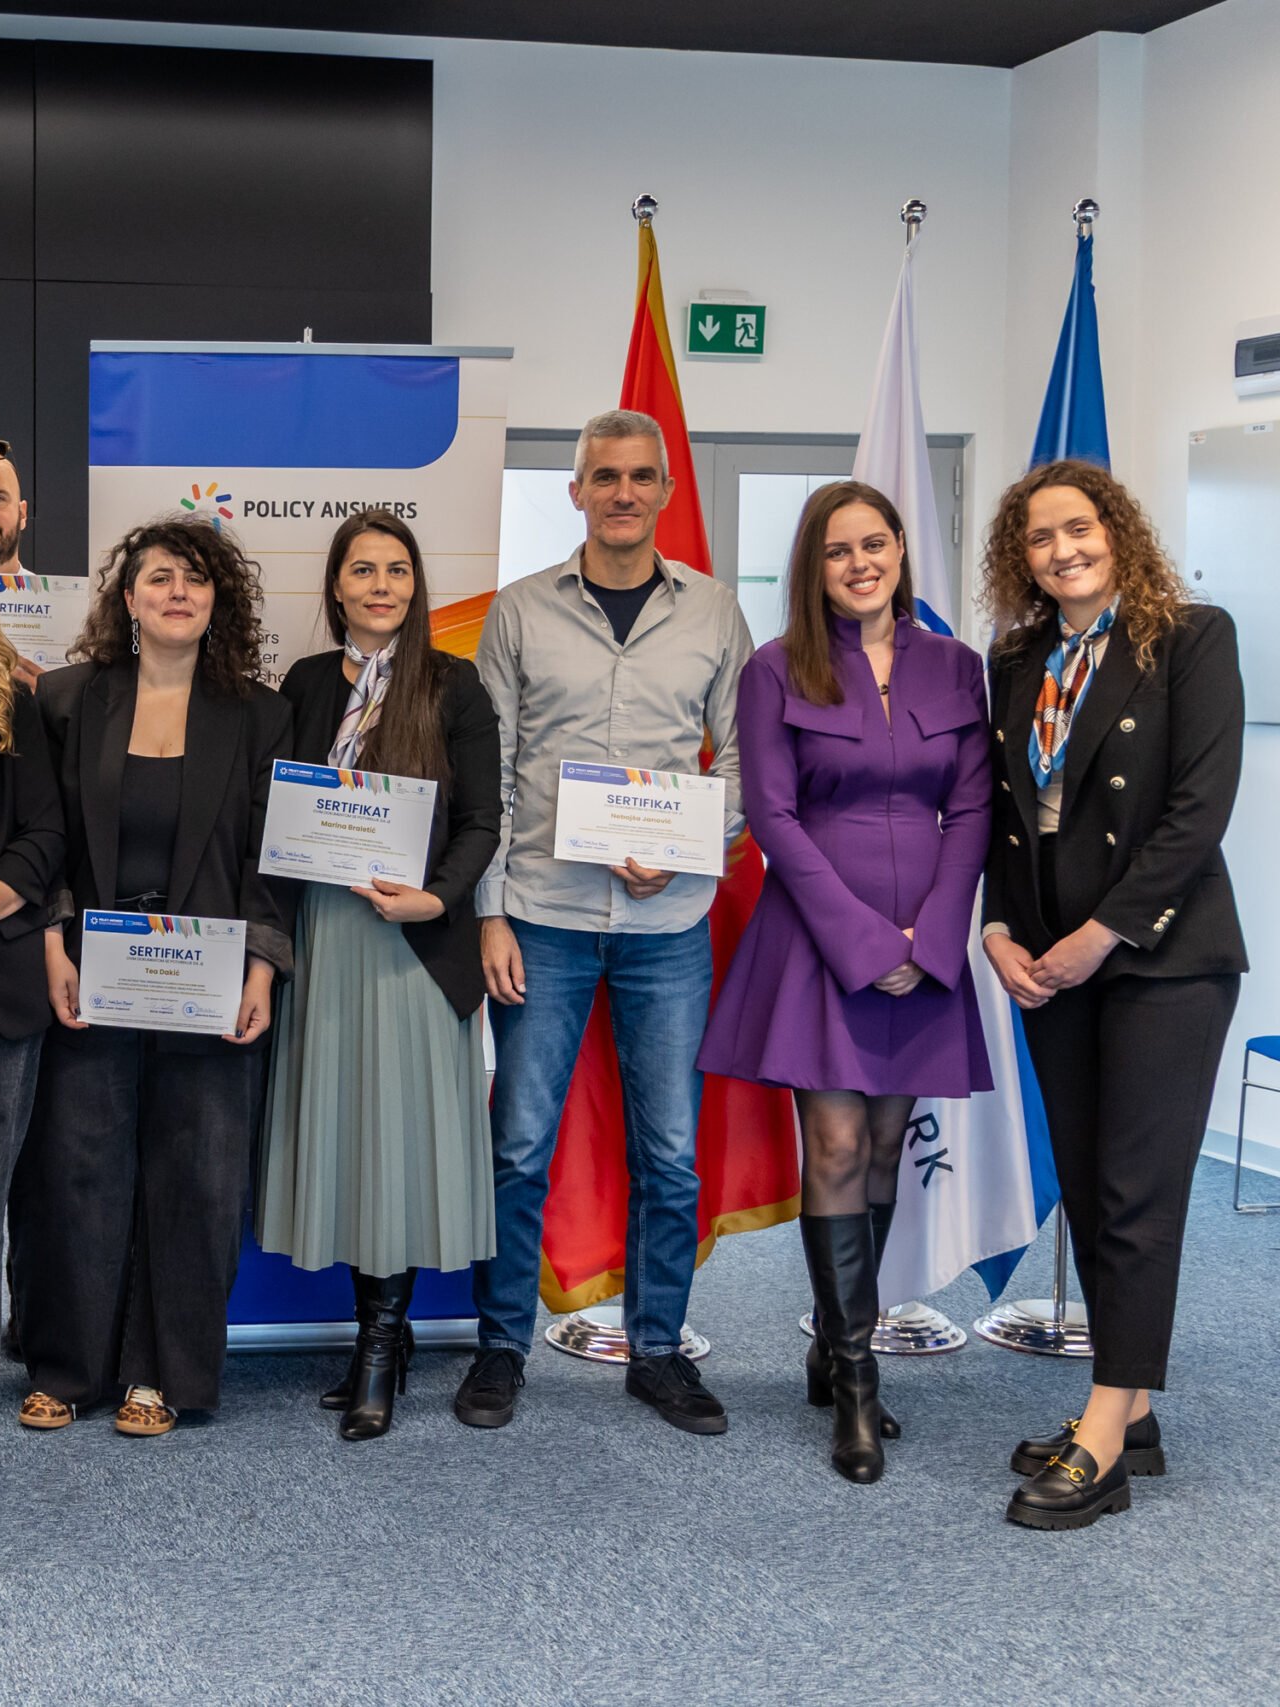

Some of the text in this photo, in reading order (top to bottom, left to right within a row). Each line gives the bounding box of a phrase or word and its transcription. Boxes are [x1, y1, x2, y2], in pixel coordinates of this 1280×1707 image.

[244, 500, 418, 519] POLICY ANSWERS
[316, 798, 390, 819] SERTIFIKAT
[607, 794, 681, 811] SERTIFIKAT
[320, 820, 347, 830] Marina
[129, 945, 202, 961] SERTIFIKAT
[906, 1112, 954, 1190] RK
